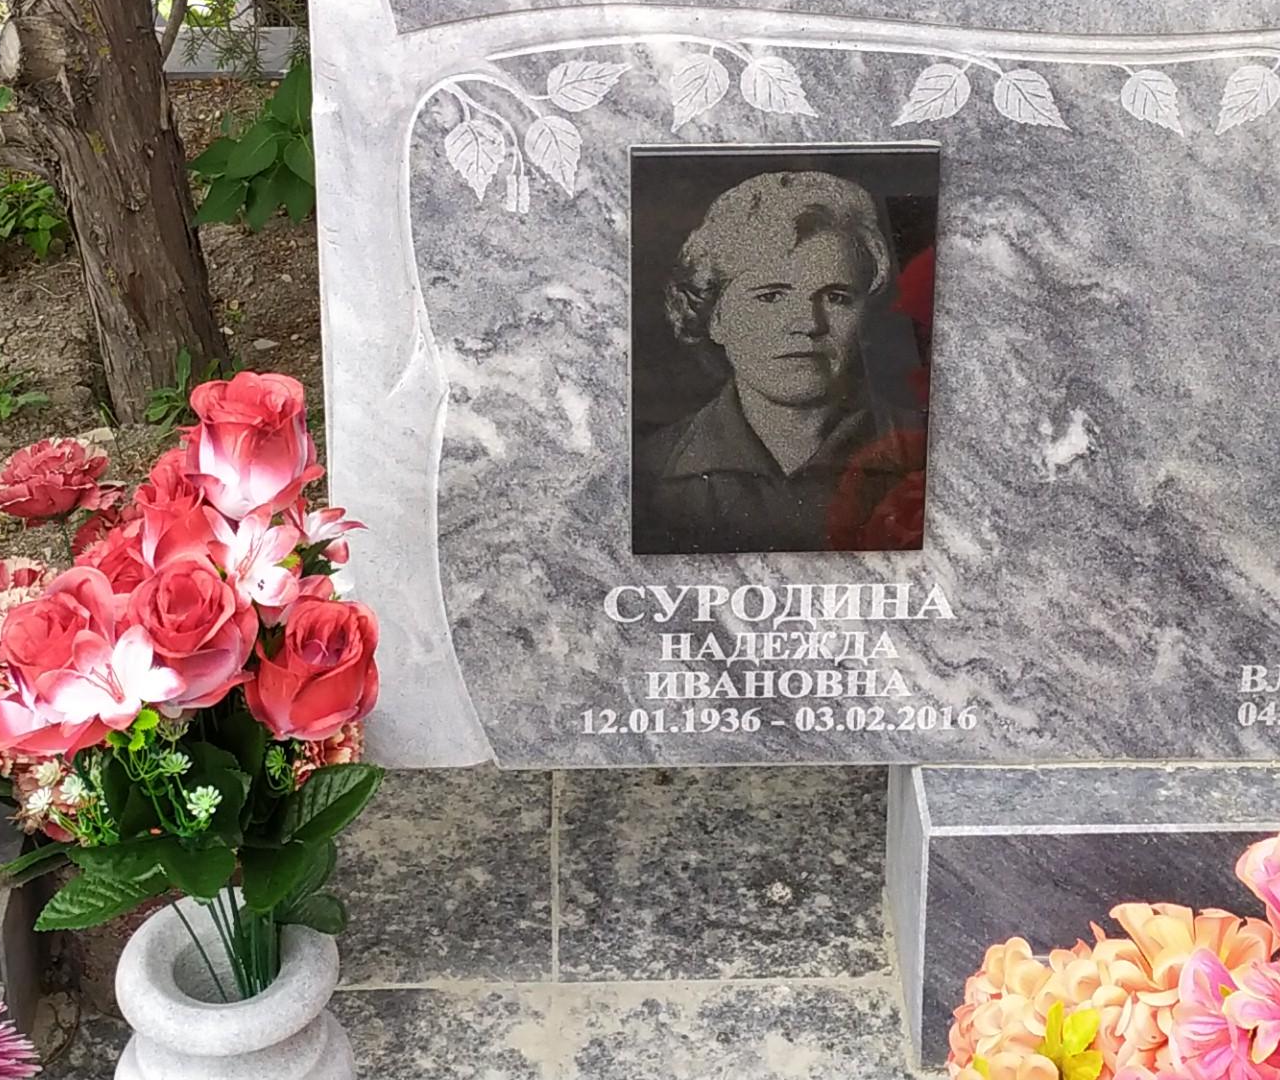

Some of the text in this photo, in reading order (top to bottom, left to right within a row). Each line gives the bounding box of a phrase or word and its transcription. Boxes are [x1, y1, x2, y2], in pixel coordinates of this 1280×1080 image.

[603, 582, 956, 630] СУРОДИНА
[659, 631, 901, 667] НАДЕЖДА
[644, 669, 913, 700] ИВАНОВНА
[580, 707, 762, 735] 12.01.1936
[795, 705, 978, 732] 03.02.2016
